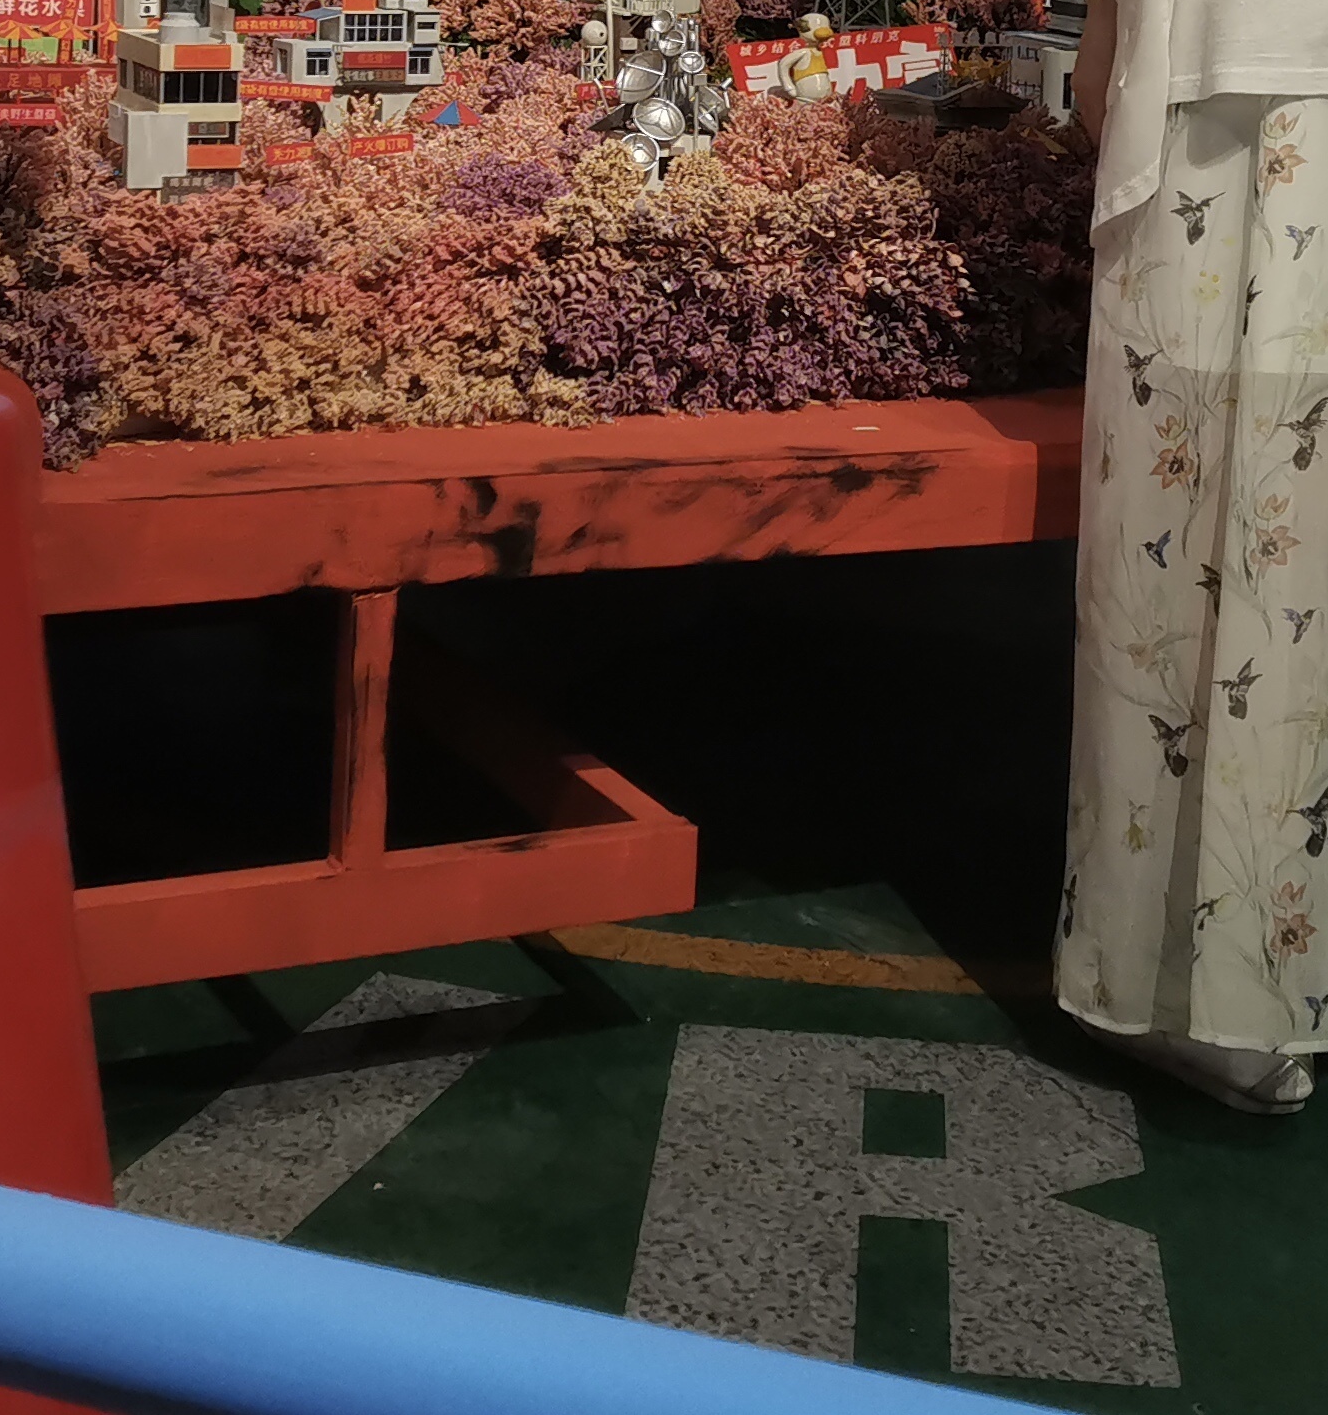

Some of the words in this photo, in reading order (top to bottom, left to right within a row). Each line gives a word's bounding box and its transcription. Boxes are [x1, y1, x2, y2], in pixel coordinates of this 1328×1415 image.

[739, 30, 901, 57] 城乡结合式塑料朋克
